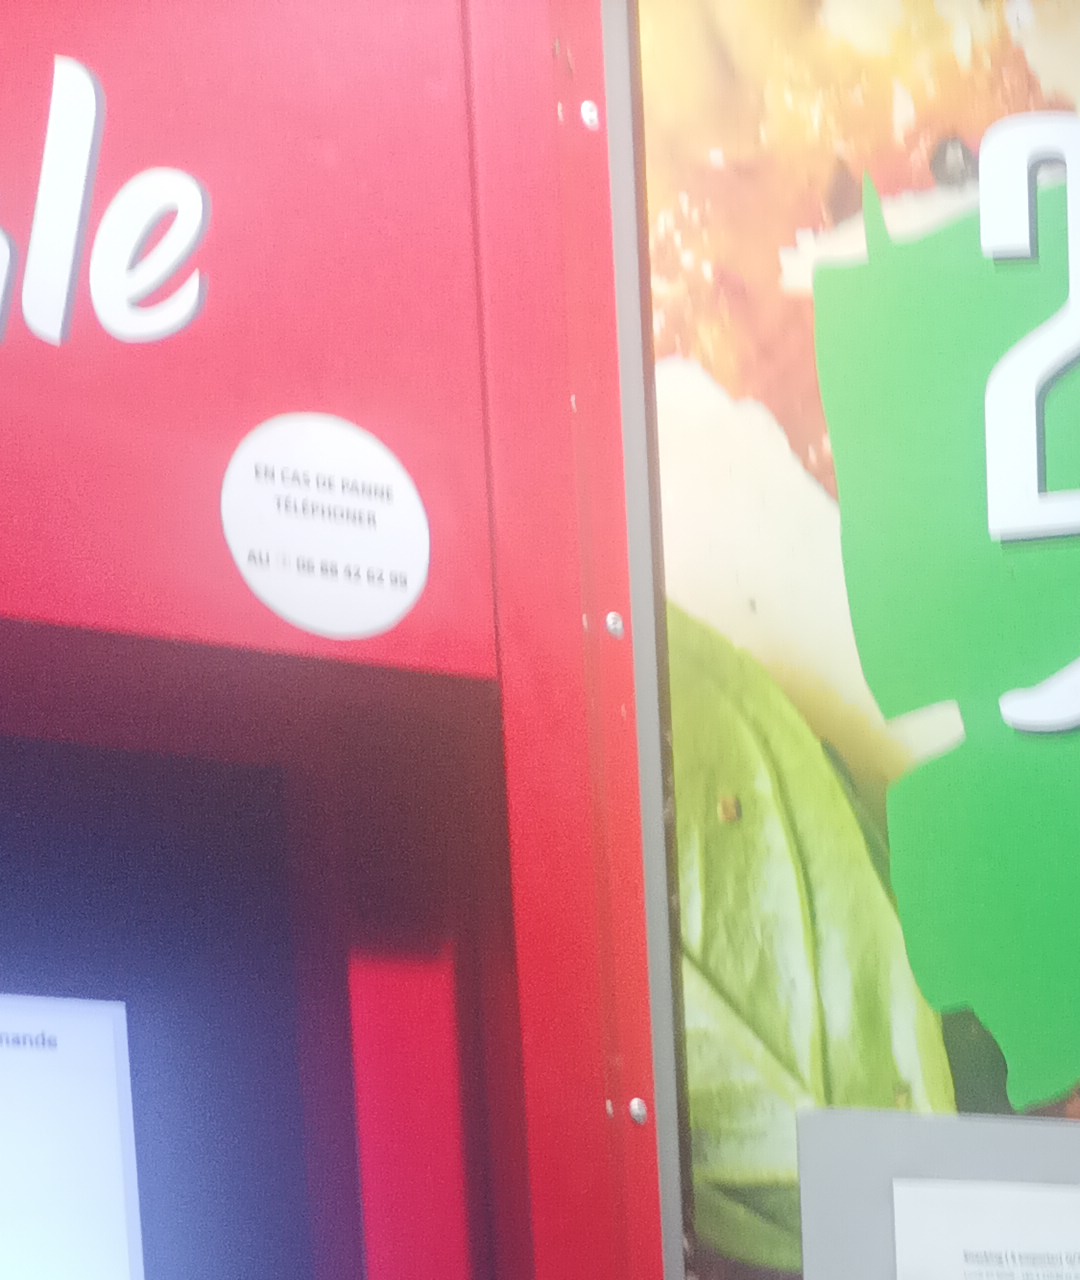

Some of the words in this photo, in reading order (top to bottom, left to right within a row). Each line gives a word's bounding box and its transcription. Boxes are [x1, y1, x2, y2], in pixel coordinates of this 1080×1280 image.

[0, 54, 211, 347] le
[254, 462, 275, 484] EN
[280, 466, 311, 488] CAS
[315, 471, 335, 492] DE
[341, 476, 394, 505] PANNE
[247, 547, 270, 568] AU
